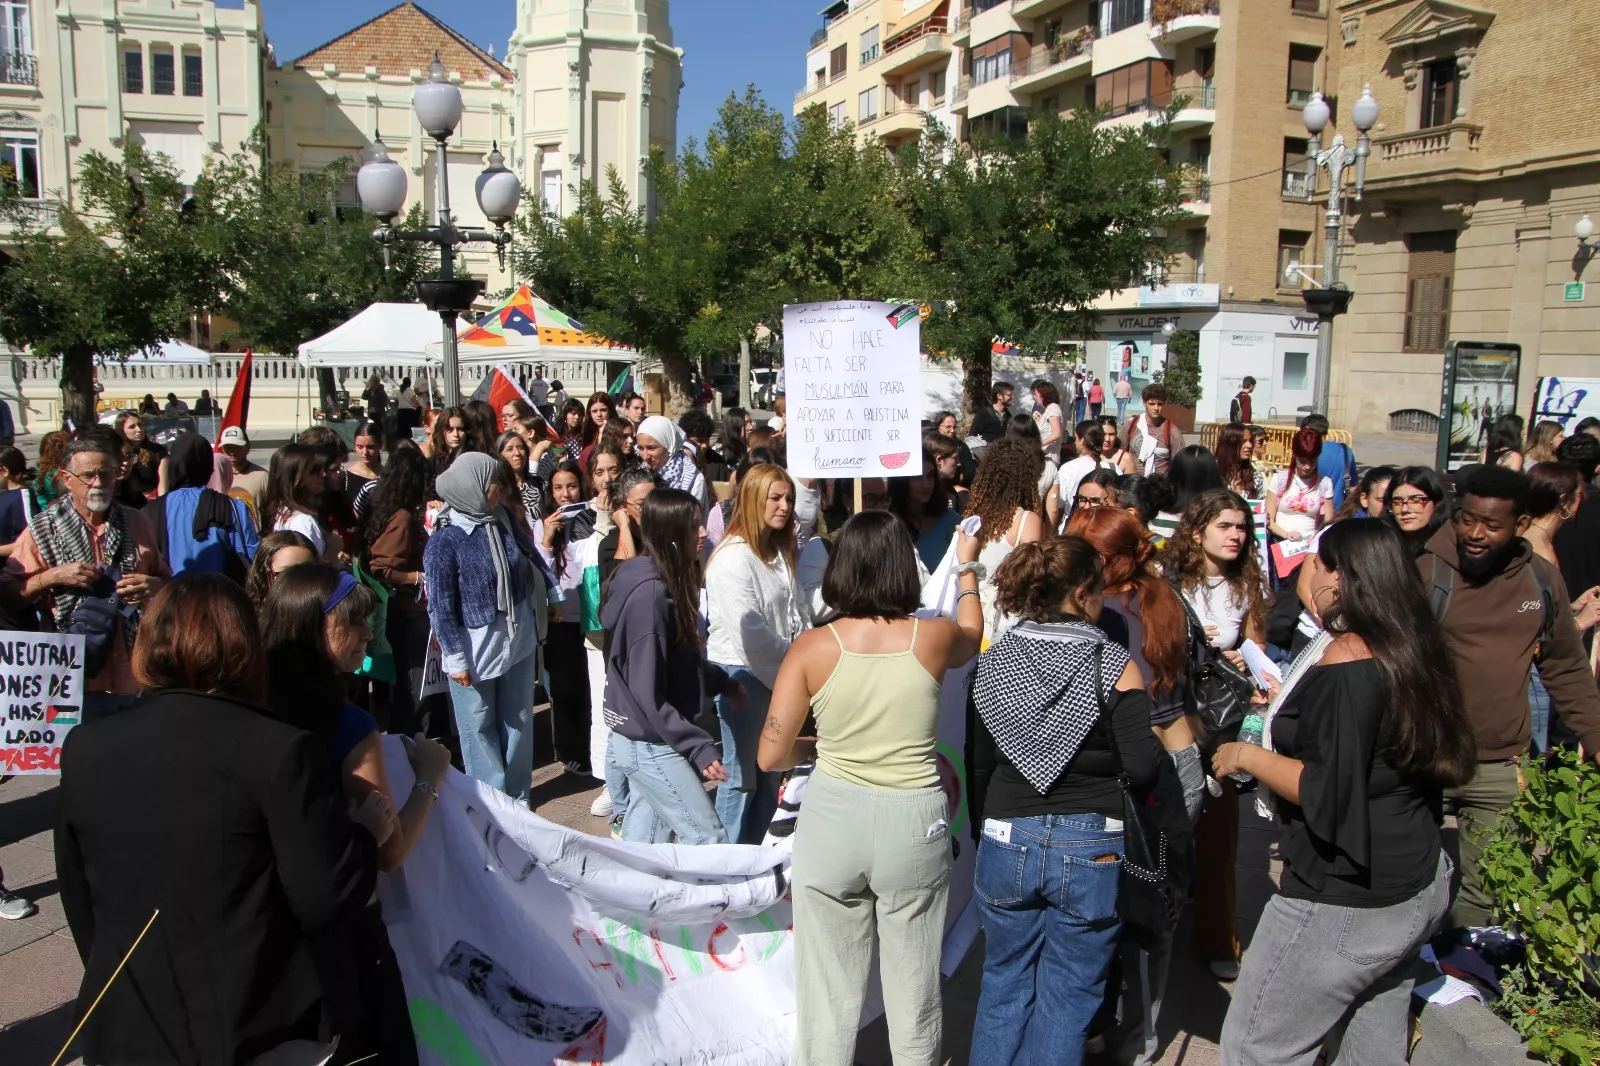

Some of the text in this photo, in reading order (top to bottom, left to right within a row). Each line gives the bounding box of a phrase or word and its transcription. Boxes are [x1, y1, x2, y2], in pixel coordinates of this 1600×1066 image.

[809, 329, 887, 351] NO HACE
[794, 356, 867, 374] FALTA SER
[804, 380, 905, 400] MUSULMÁN PARA
[797, 407, 911, 422] APOYAR A PALESTINA
[805, 428, 901, 443] ES SUFICIENTE SER
[0, 641, 82, 669] NEUTRAL
[48, 673, 72, 698] DE
[8, 701, 45, 721] HAS
[5, 729, 56, 744] LADO
